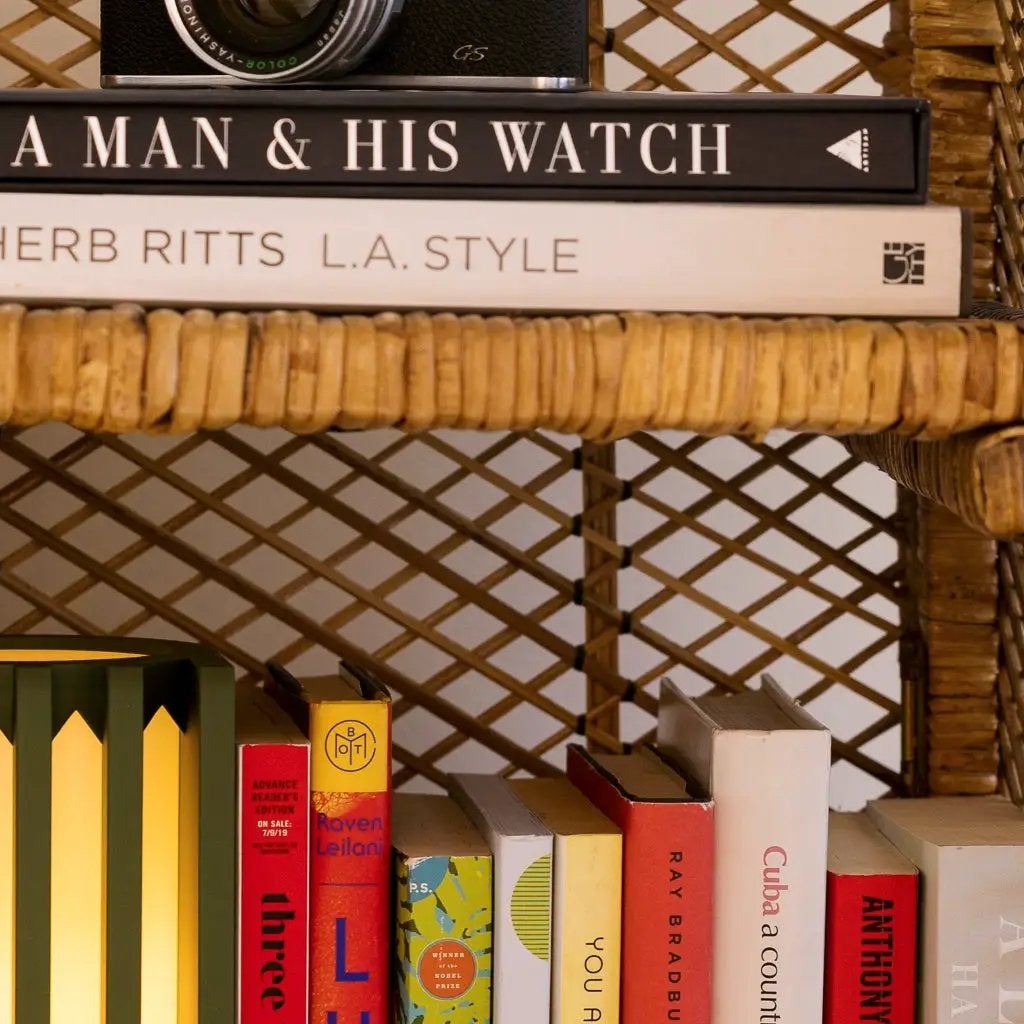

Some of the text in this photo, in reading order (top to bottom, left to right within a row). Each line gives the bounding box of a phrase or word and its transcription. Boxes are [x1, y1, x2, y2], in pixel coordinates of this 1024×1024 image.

[452, 45, 489, 62] GS
[9, 115, 732, 176] A MAN & HIS WATCH
[143, 229, 286, 269] RITTS
[322, 233, 409, 272] L.A.
[424, 235, 580, 276] STYLE
[257, 820, 292, 828] ON SALE:
[317, 813, 383, 832] Raven
[317, 837, 384, 857] Leilani
[409, 882, 433, 893] P.S.
[669, 850, 685, 899] RAY
[763, 846, 790, 916] Cuba
[260, 893, 296, 1010] three
[762, 923, 780, 938] a
[583, 936, 605, 993] YOU
[858, 896, 894, 1024] ANTHONY
